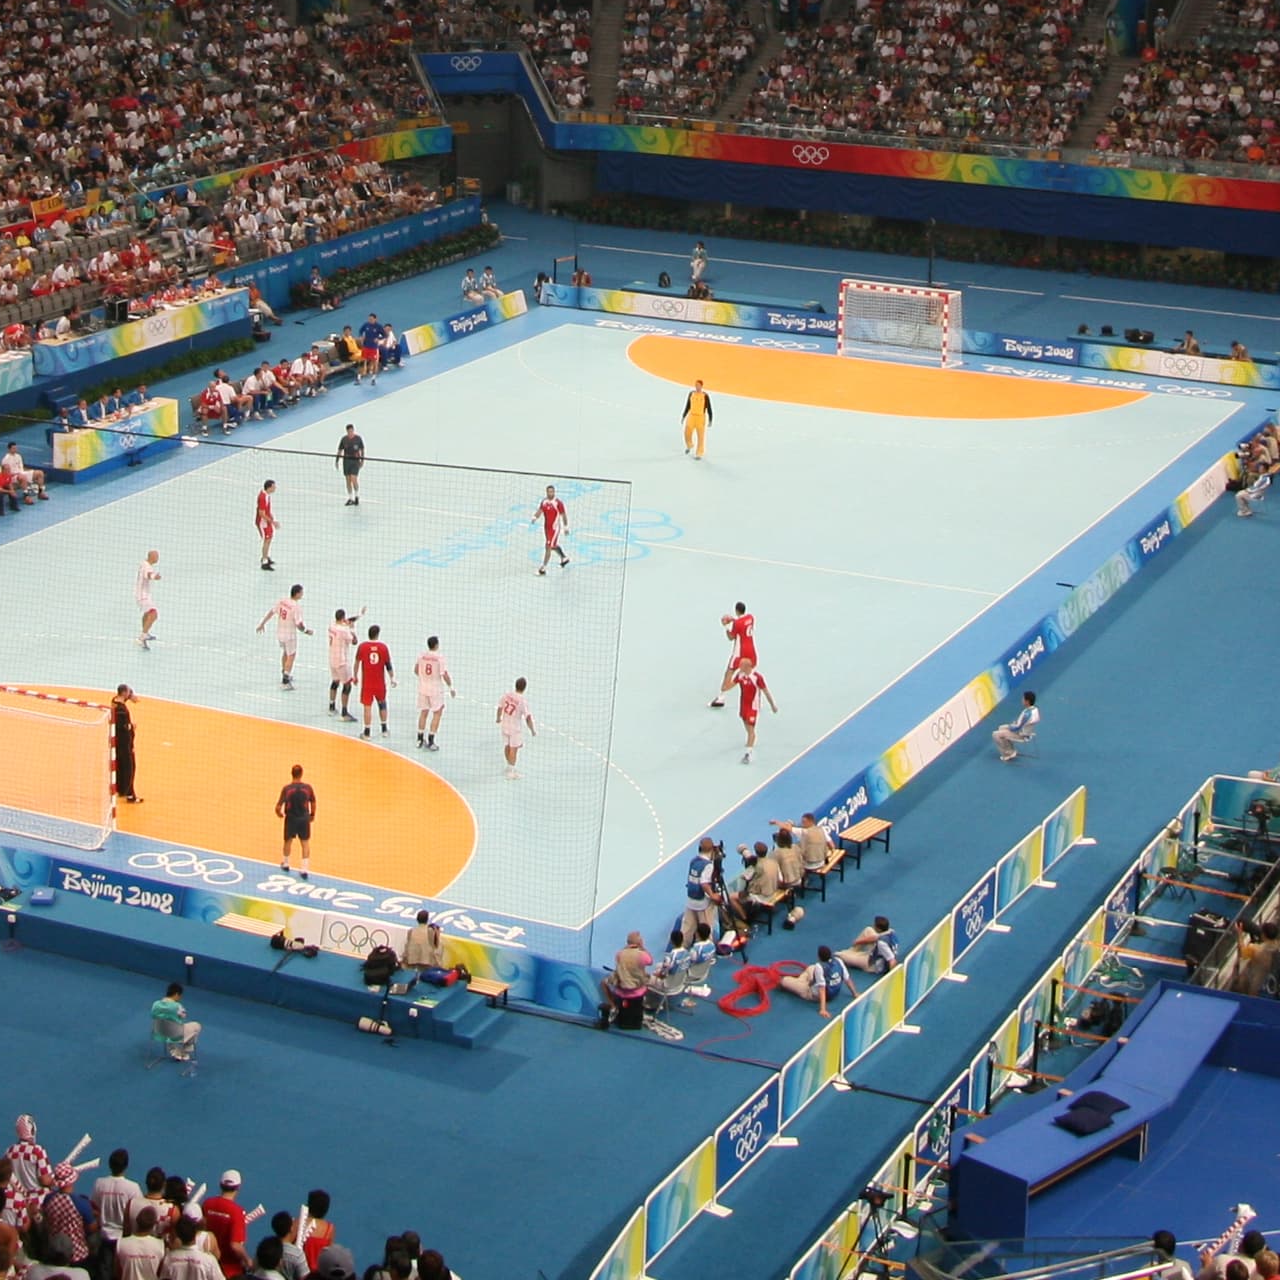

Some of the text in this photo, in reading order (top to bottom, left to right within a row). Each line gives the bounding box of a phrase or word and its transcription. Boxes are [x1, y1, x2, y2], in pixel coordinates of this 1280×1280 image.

[450, 310, 488, 333] Beijing 2008
[594, 318, 743, 343] Beijing 2008
[767, 312, 836, 332] Beijing 2008
[1002, 338, 1074, 360] Beijing 2008
[982, 363, 1146, 390] Beijing 2008
[1139, 520, 1170, 554] Beijing 2008
[369, 652, 380, 665] 9
[425, 663, 433, 676] 8
[1008, 636, 1045, 677] Beijing 2008
[505, 700, 516, 716] 27
[817, 785, 868, 837] Beijing 2008
[59, 868, 174, 914] Beijing 2008
[962, 882, 989, 919] Beijing 2008
[256, 874, 528, 949] Beijing 2008
[728, 1094, 769, 1141] Beijing 2008
